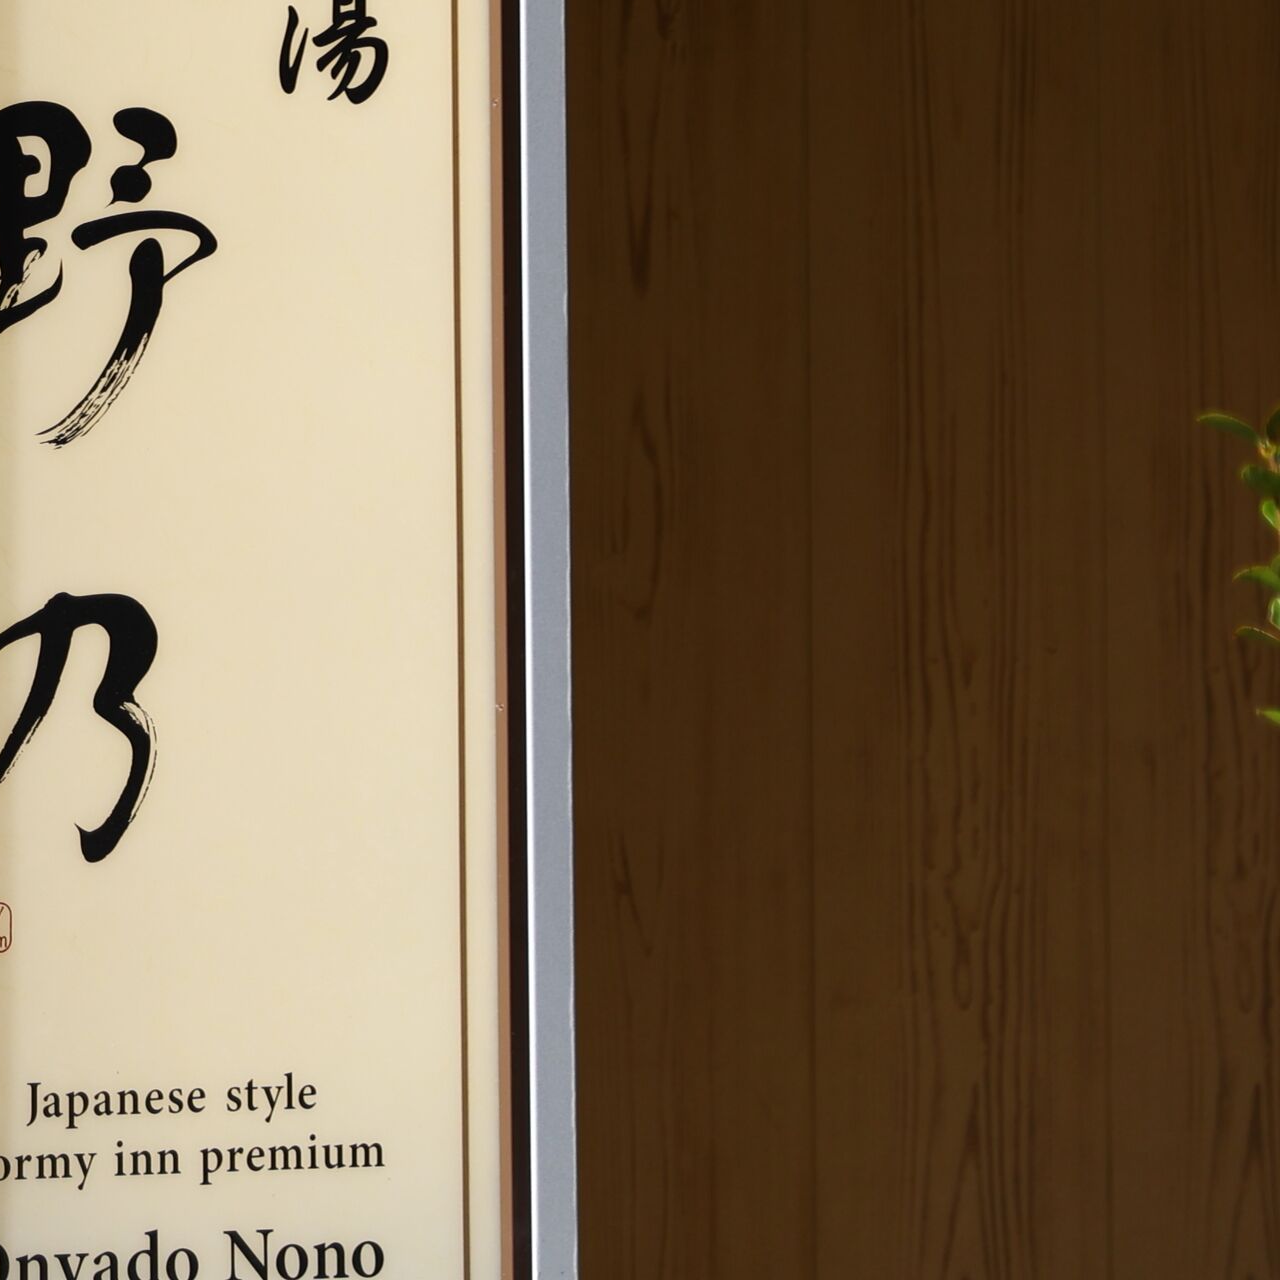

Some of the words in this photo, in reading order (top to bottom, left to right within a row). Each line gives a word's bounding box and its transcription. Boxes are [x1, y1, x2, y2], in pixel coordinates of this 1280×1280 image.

[26, 1082, 207, 1129] Japanese
[226, 1072, 318, 1122] style
[114, 1141, 181, 1177] inn
[200, 1134, 385, 1185] premium
[224, 1228, 385, 1280] Nono
